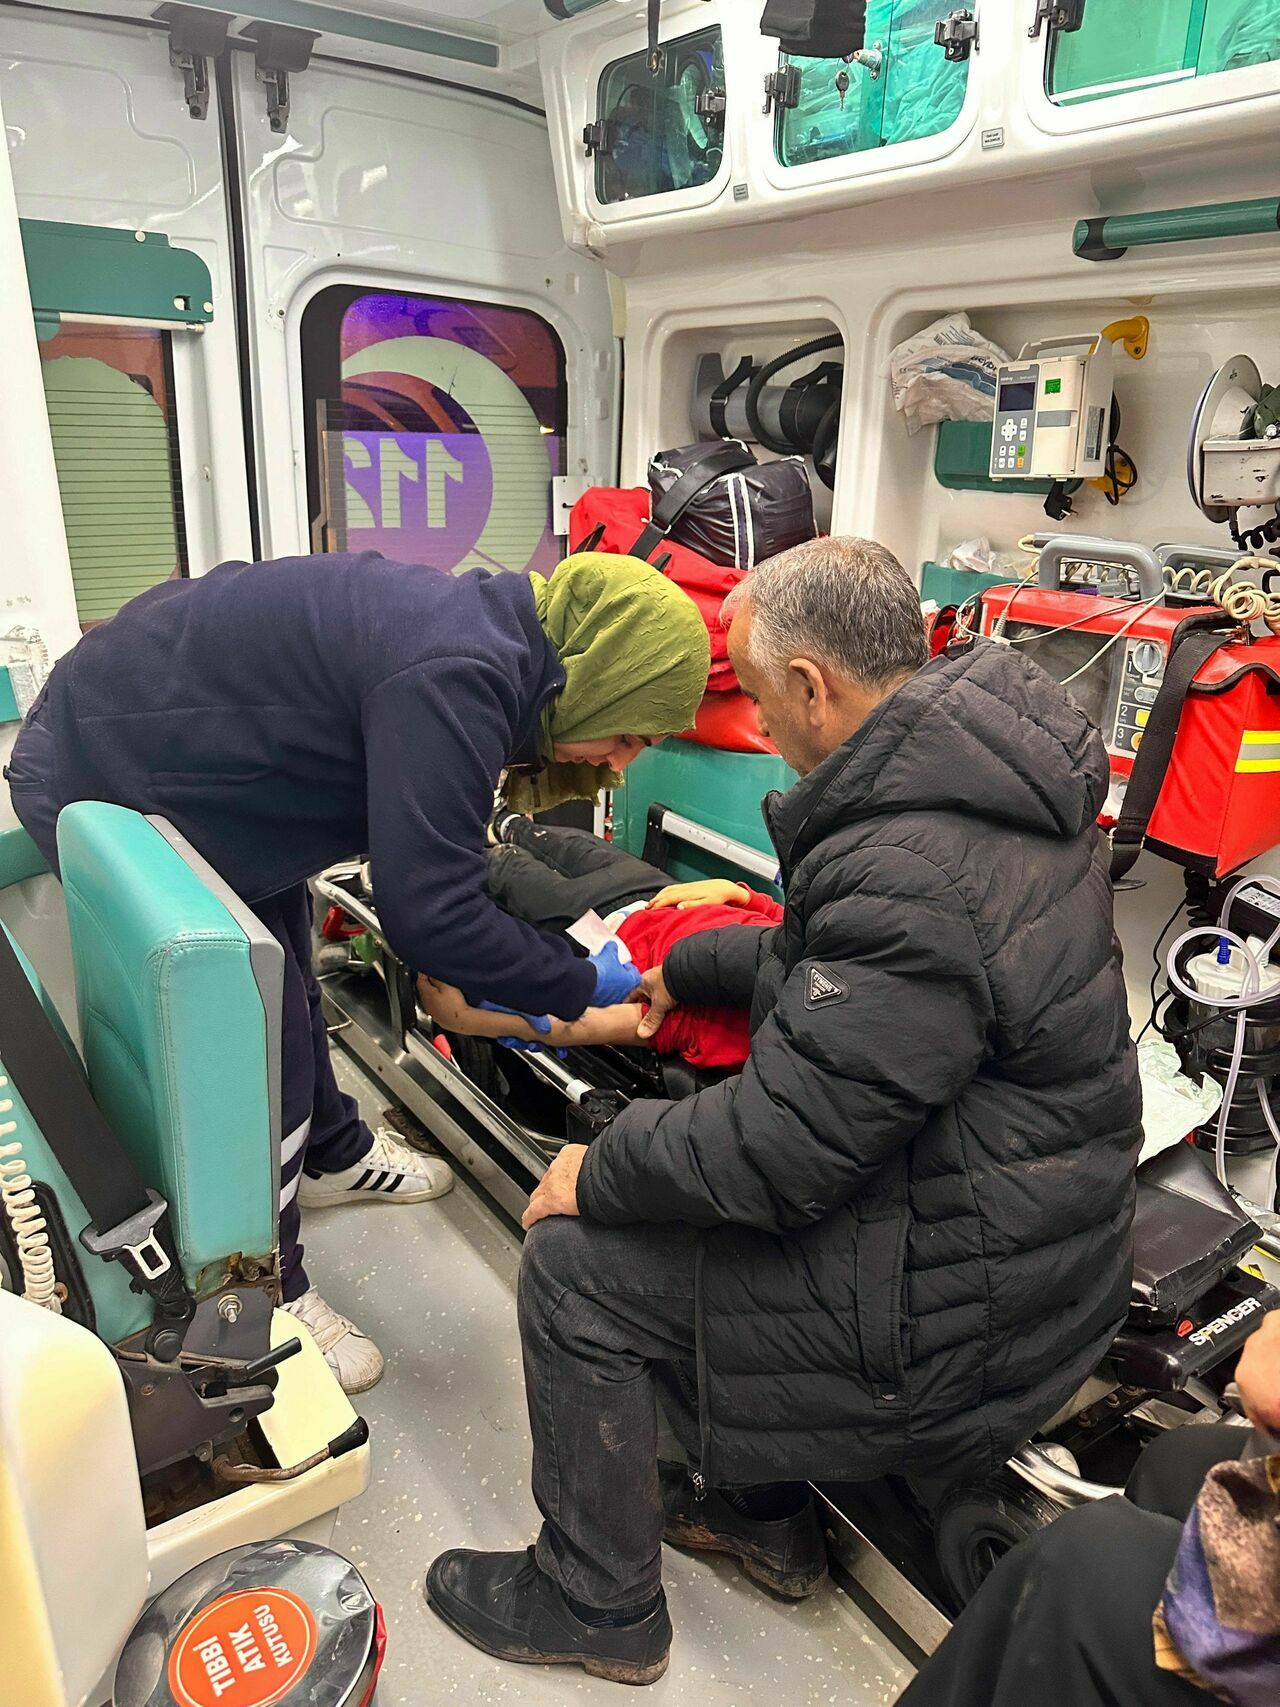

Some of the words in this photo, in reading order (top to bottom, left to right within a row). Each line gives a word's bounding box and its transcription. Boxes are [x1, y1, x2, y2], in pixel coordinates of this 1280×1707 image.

[1128, 660, 1133, 672] 1
[1117, 727, 1124, 739] 3
[1120, 705, 1128, 717] 2
[1188, 1297, 1261, 1346] SPENCER
[228, 1622, 267, 1673] ATIK
[253, 1604, 293, 1668] KUTUSU
[192, 1635, 236, 1697] TIBBİ
